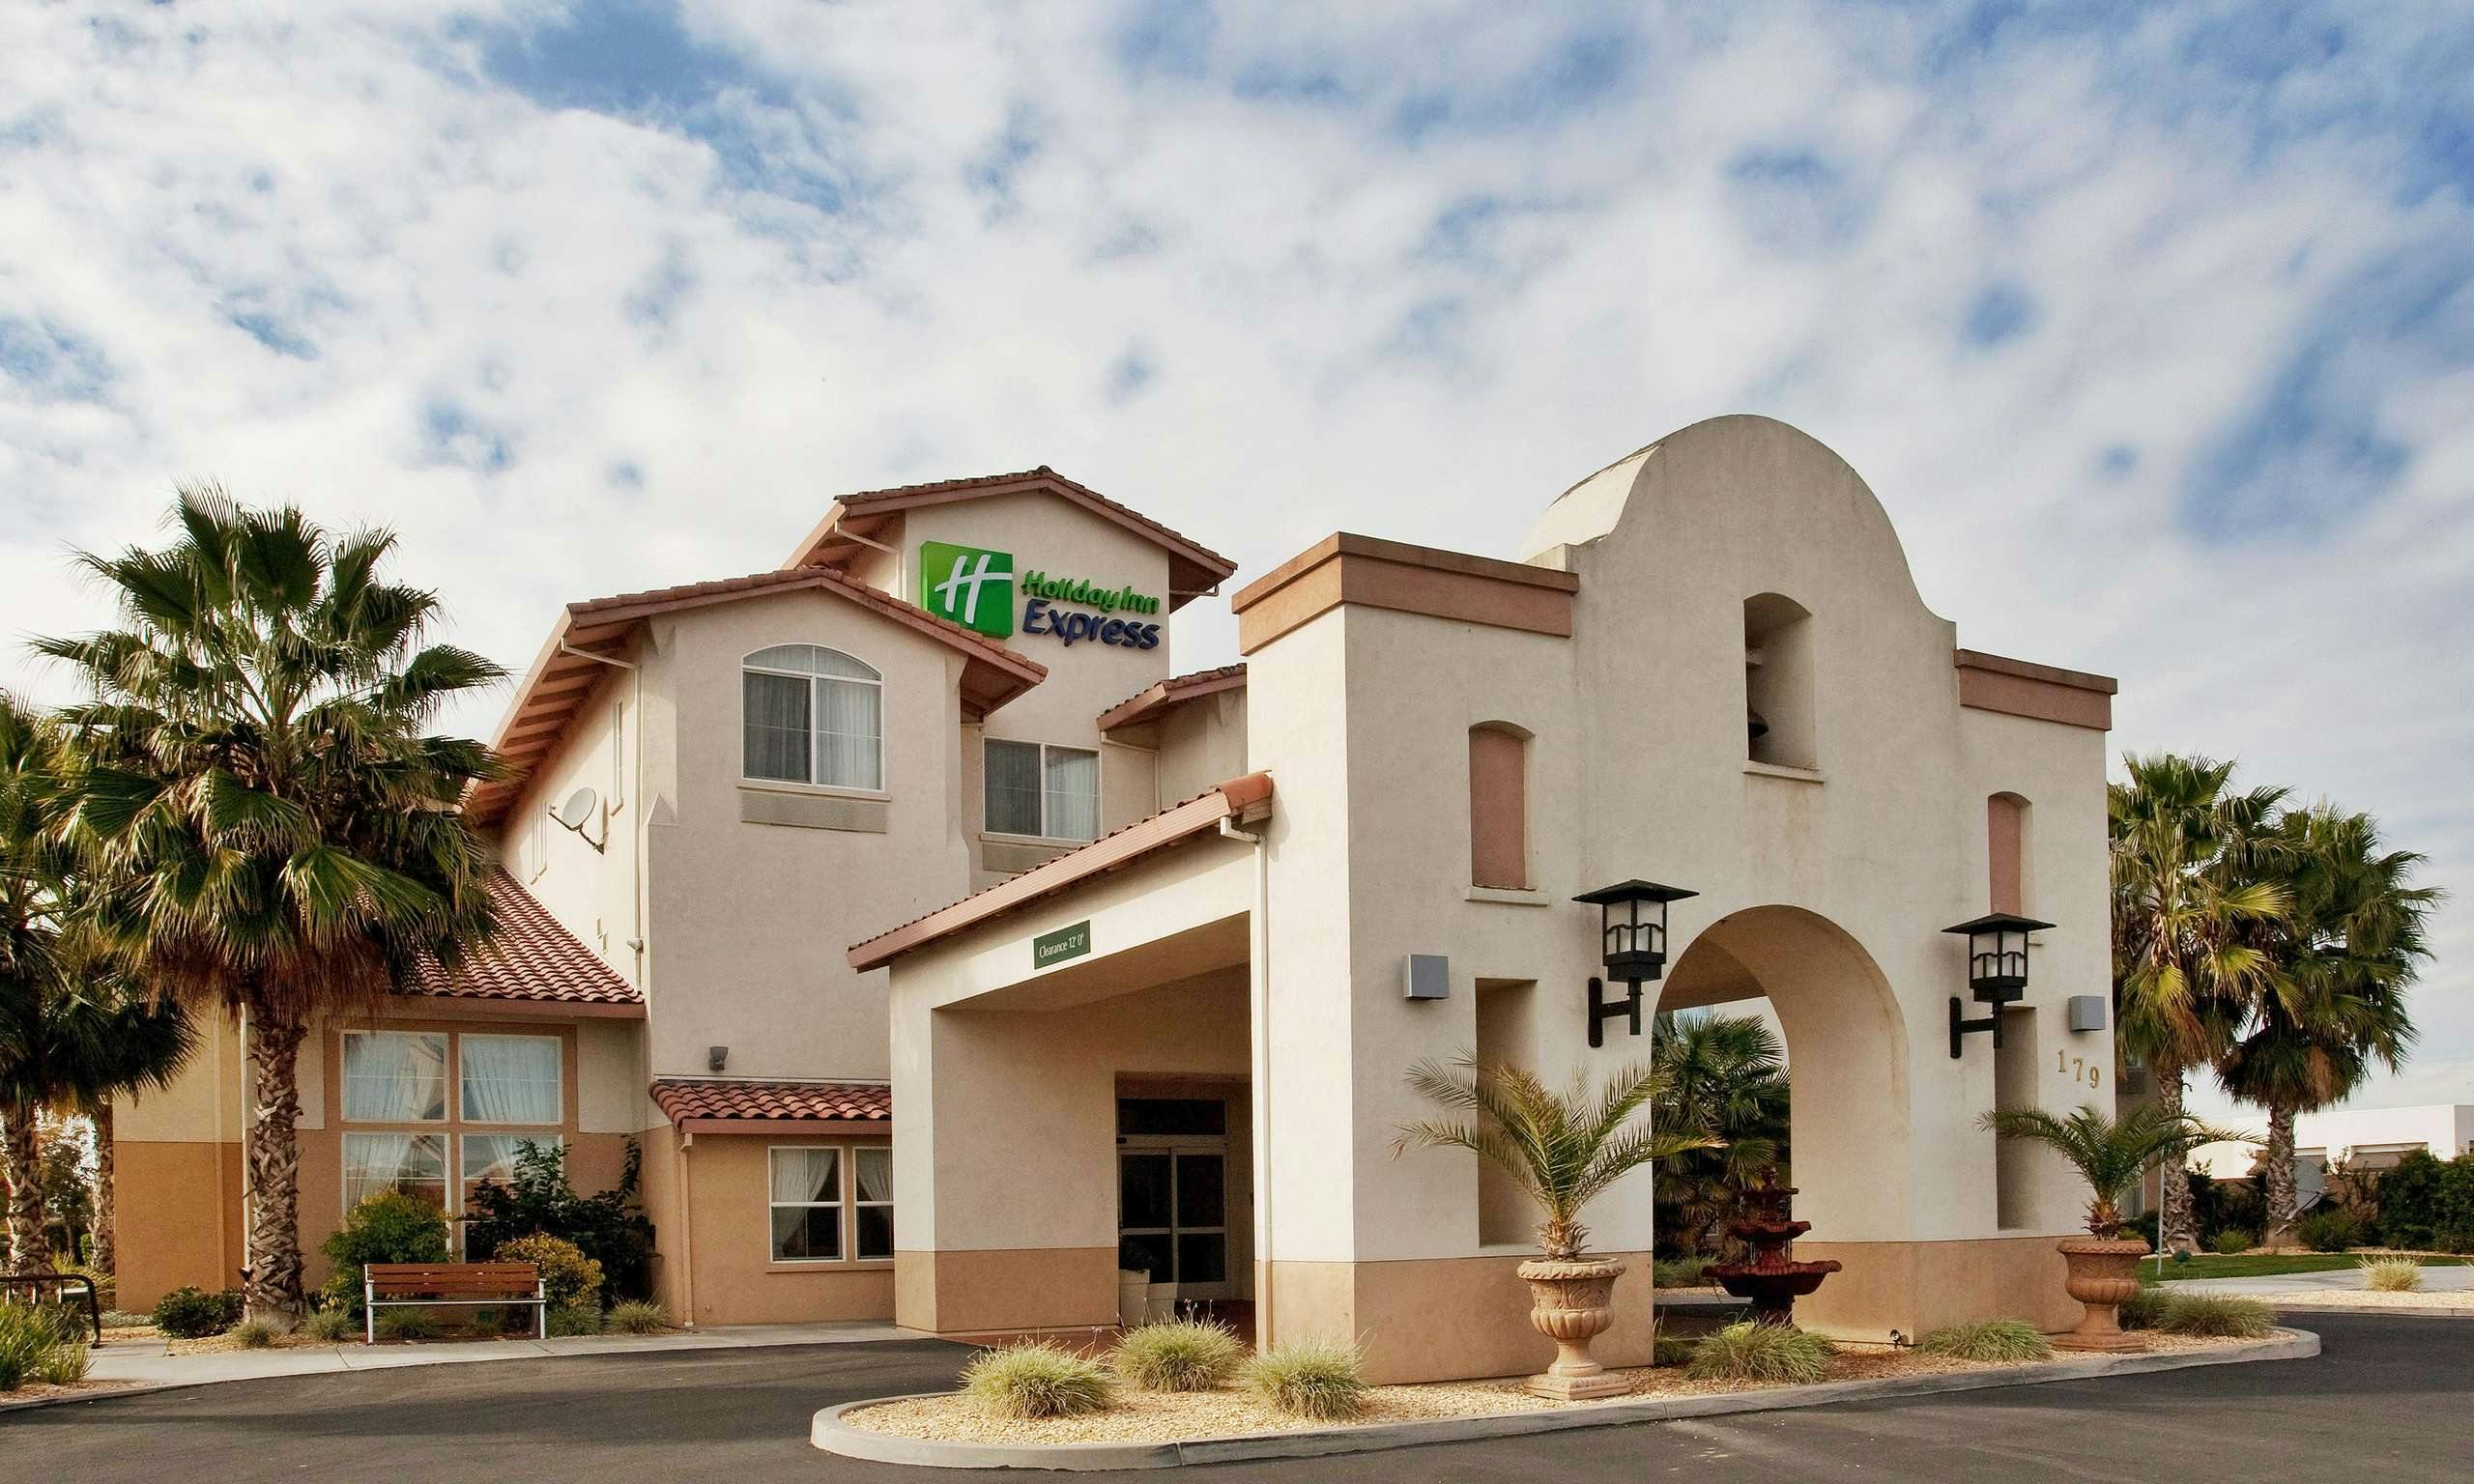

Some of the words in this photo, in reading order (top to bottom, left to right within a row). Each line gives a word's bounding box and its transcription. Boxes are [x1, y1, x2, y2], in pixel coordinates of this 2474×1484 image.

[935, 554, 1013, 624] H
[1021, 570, 1119, 614] Holiday
[1120, 585, 1160, 614] Inn
[1022, 598, 1160, 649] Express
[1039, 941, 1068, 958] Clearance
[2057, 1049, 2100, 1089] 179
